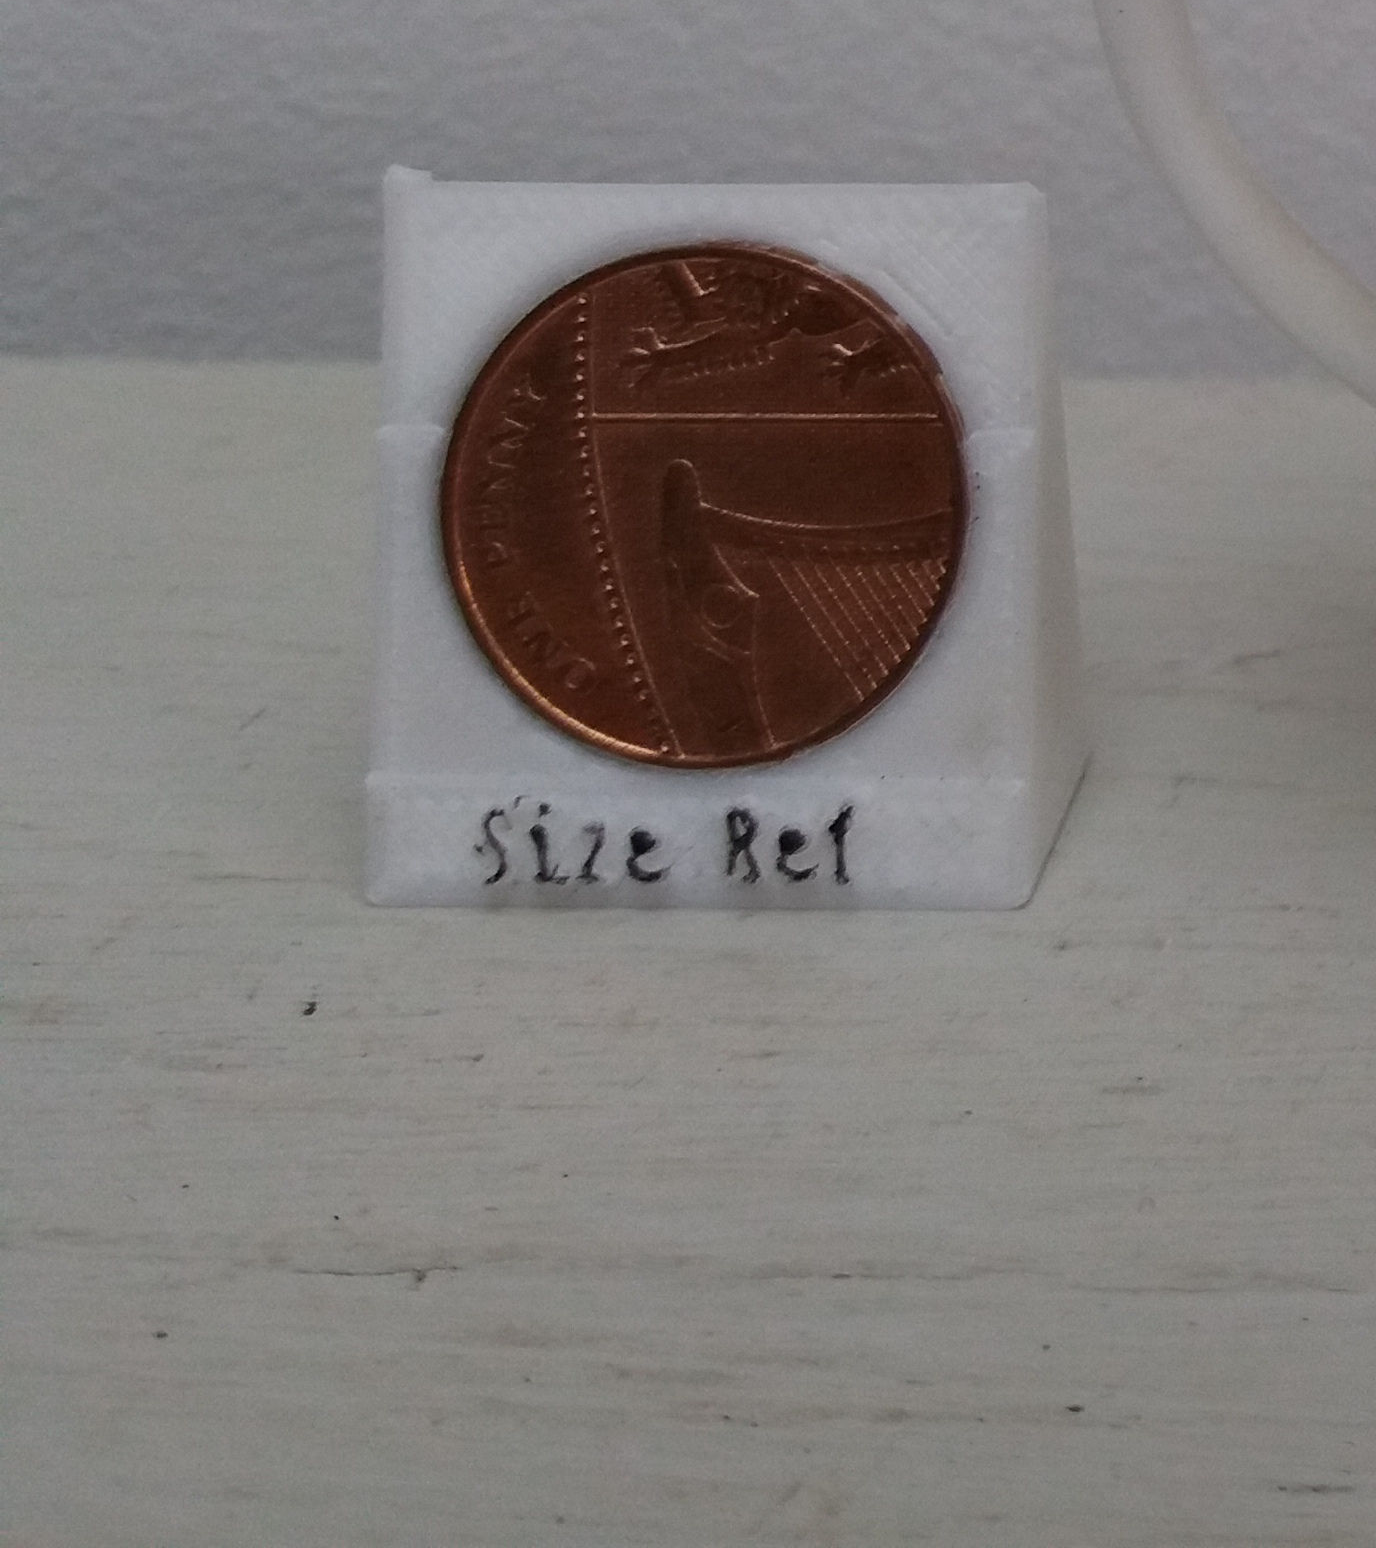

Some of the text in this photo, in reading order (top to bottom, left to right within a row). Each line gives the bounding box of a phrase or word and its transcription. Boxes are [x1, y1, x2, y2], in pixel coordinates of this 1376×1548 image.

[479, 372, 598, 695] ONE PENNY
[475, 795, 857, 885] Size Ref
